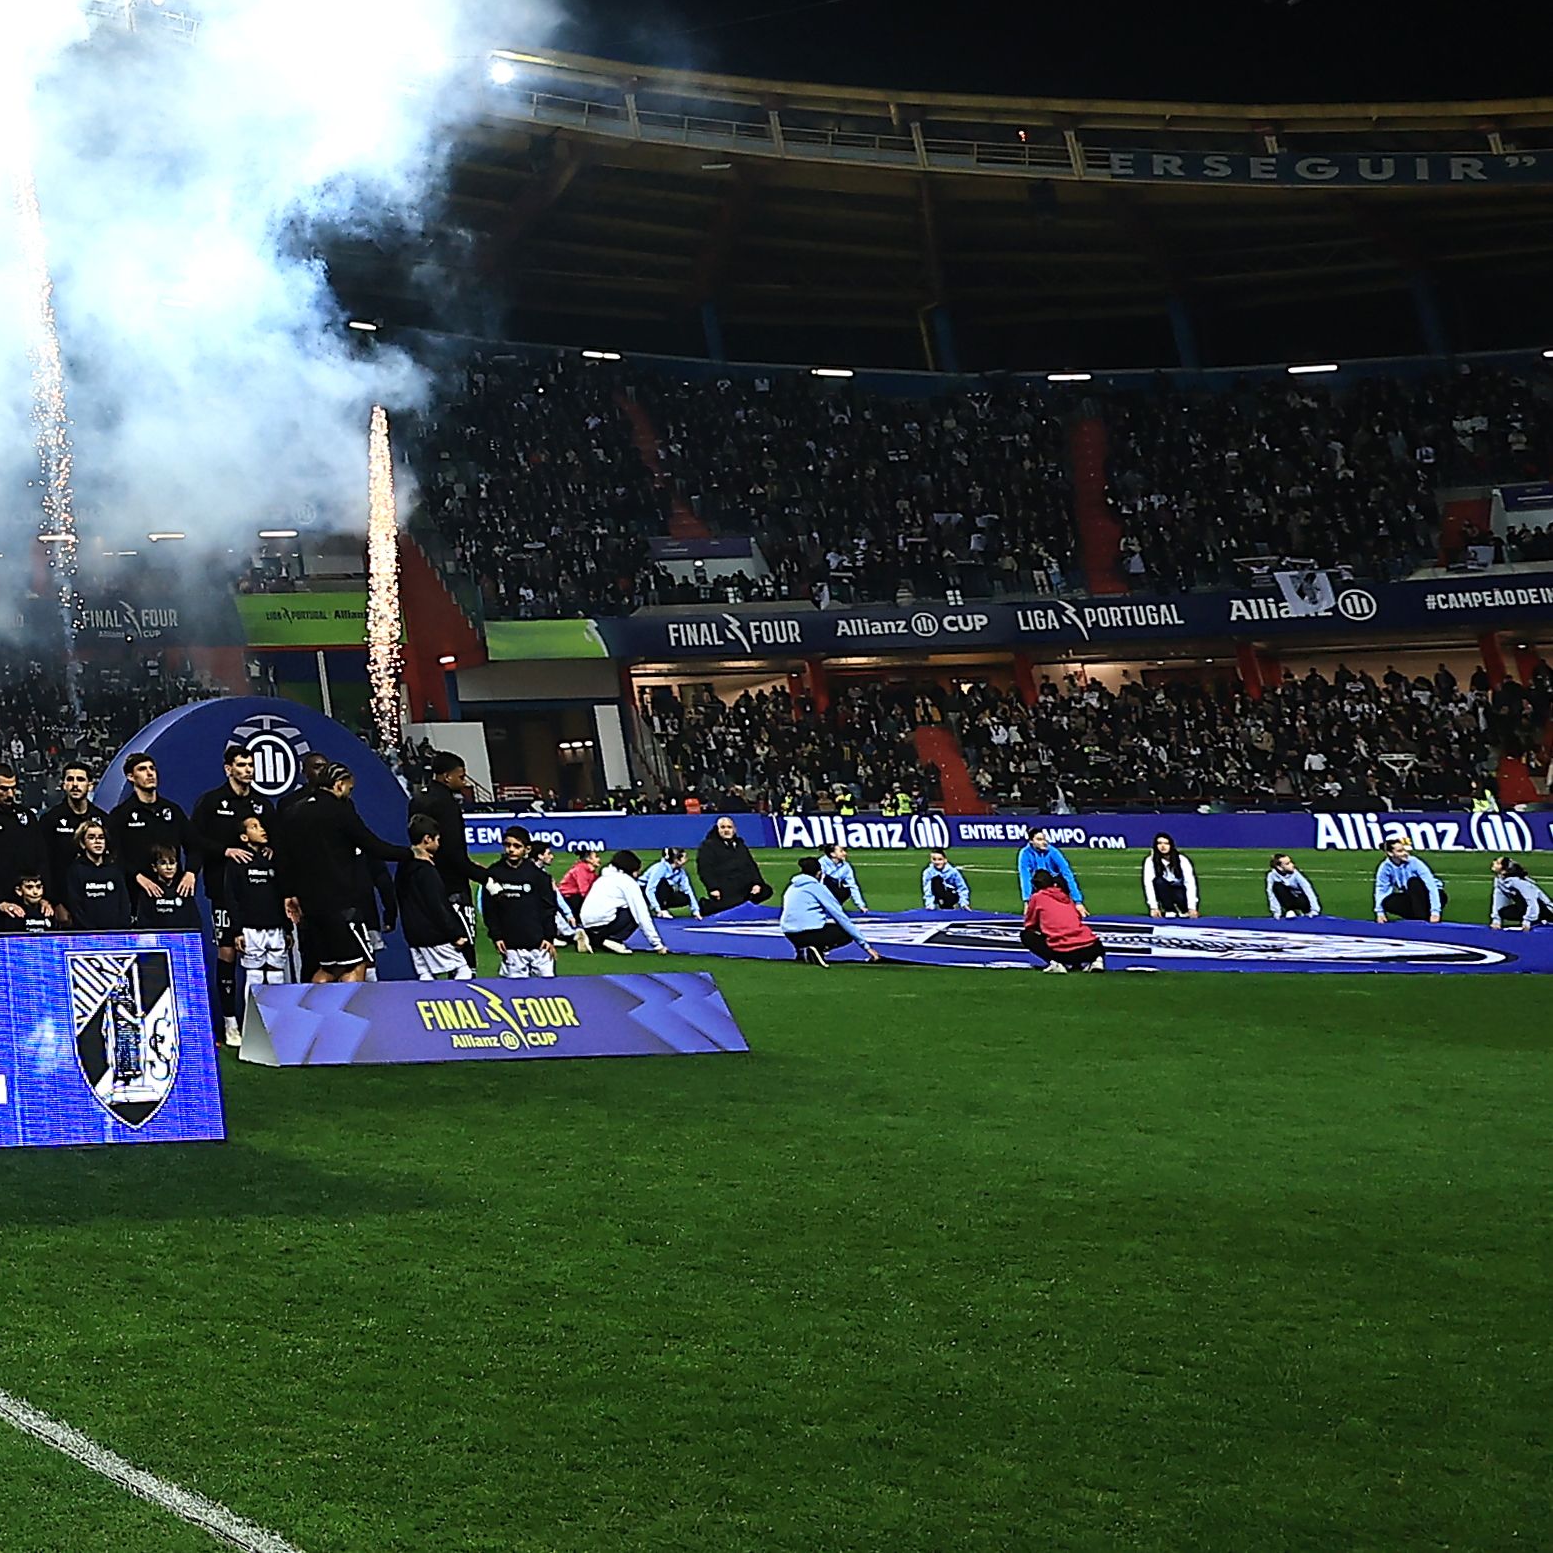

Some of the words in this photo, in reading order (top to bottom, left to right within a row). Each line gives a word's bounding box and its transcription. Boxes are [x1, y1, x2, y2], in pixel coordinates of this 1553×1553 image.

[141, 608, 178, 628] FOUR
[334, 609, 368, 621] Allian
[1016, 606, 1060, 632] LIGA
[1084, 602, 1185, 630] PORTUGAL
[1230, 599, 1333, 622] Allia
[668, 622, 725, 647] FINAL
[749, 620, 802, 645] FOUR
[836, 618, 909, 638] Allianz
[942, 614, 989, 633] CUP
[477, 827, 503, 844] EM
[782, 815, 908, 848] Allianz
[959, 823, 1006, 841] ENTRE
[1006, 825, 1028, 841] EM
[1042, 828, 1086, 844] AMPO
[1089, 836, 1127, 849] COM
[1314, 813, 1460, 851] Allianz
[416, 998, 491, 1031] FINAL
[511, 996, 581, 1028] FOUR
[450, 1033, 501, 1049] Allianz
[527, 1031, 558, 1046] CUP
